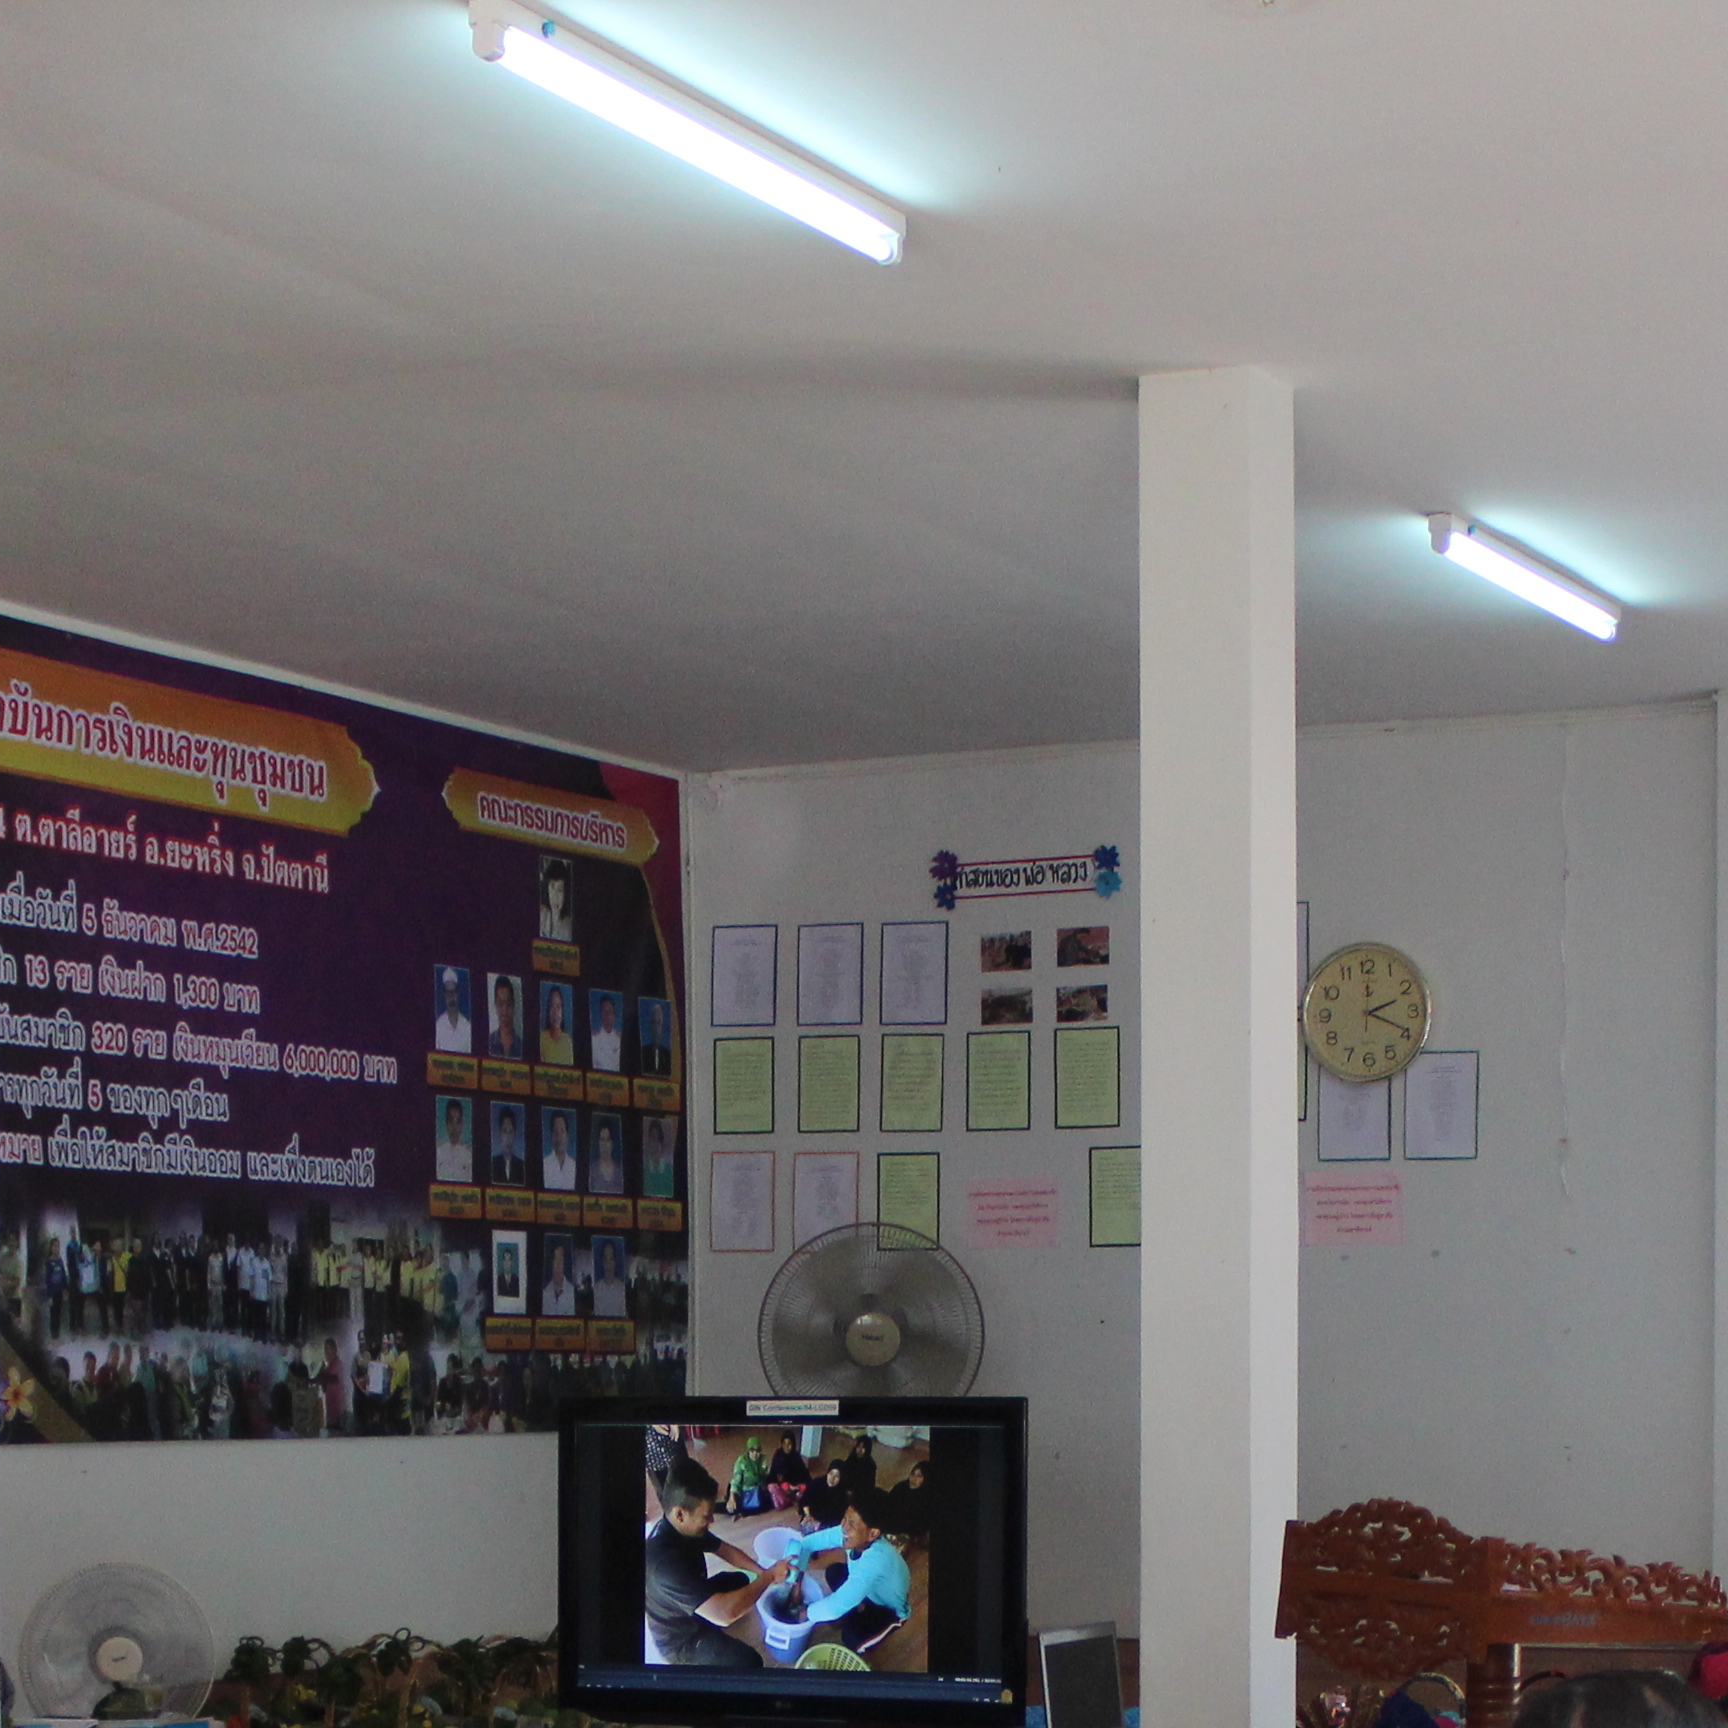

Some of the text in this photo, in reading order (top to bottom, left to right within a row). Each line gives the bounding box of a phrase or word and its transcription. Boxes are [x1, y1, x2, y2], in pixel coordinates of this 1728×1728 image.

[478, 794, 627, 850] คณะกรรมการบริหาร
[14, 808, 138, 862] ต.ตาลีอายร์
[144, 822, 235, 877] อ.ยะหริ่ง
[241, 846, 330, 894] จ.ปัตตานี
[82, 903, 97, 936] 5
[102, 898, 177, 947] ธันวาคม
[181, 919, 259, 959] พ.ศ.2542
[1339, 965, 1353, 981] 11
[1359, 959, 1375, 975] 12
[25, 954, 50, 989] 13
[54, 960, 93, 994] ราย
[98, 955, 167, 1002] เงินฝาก
[173, 973, 220, 1009] 1,300
[223, 982, 261, 1014] บาท
[1399, 979, 1412, 996] 2
[1322, 985, 1340, 1001] 10
[1318, 1007, 1332, 1024] 9
[1407, 1003, 1420, 1019] 3
[1325, 1030, 1338, 1046] 8
[1399, 1026, 1412, 1042] 4
[91, 1020, 129, 1055] 320
[133, 1027, 168, 1060] ราย
[283, 1043, 360, 1081] 6,000,000
[363, 1053, 398, 1083] บาท
[1343, 1046, 1355, 1063] 7
[1362, 1052, 1376, 1068] 6
[1384, 1044, 1397, 1061] 5
[87, 1079, 102, 1111] 5
